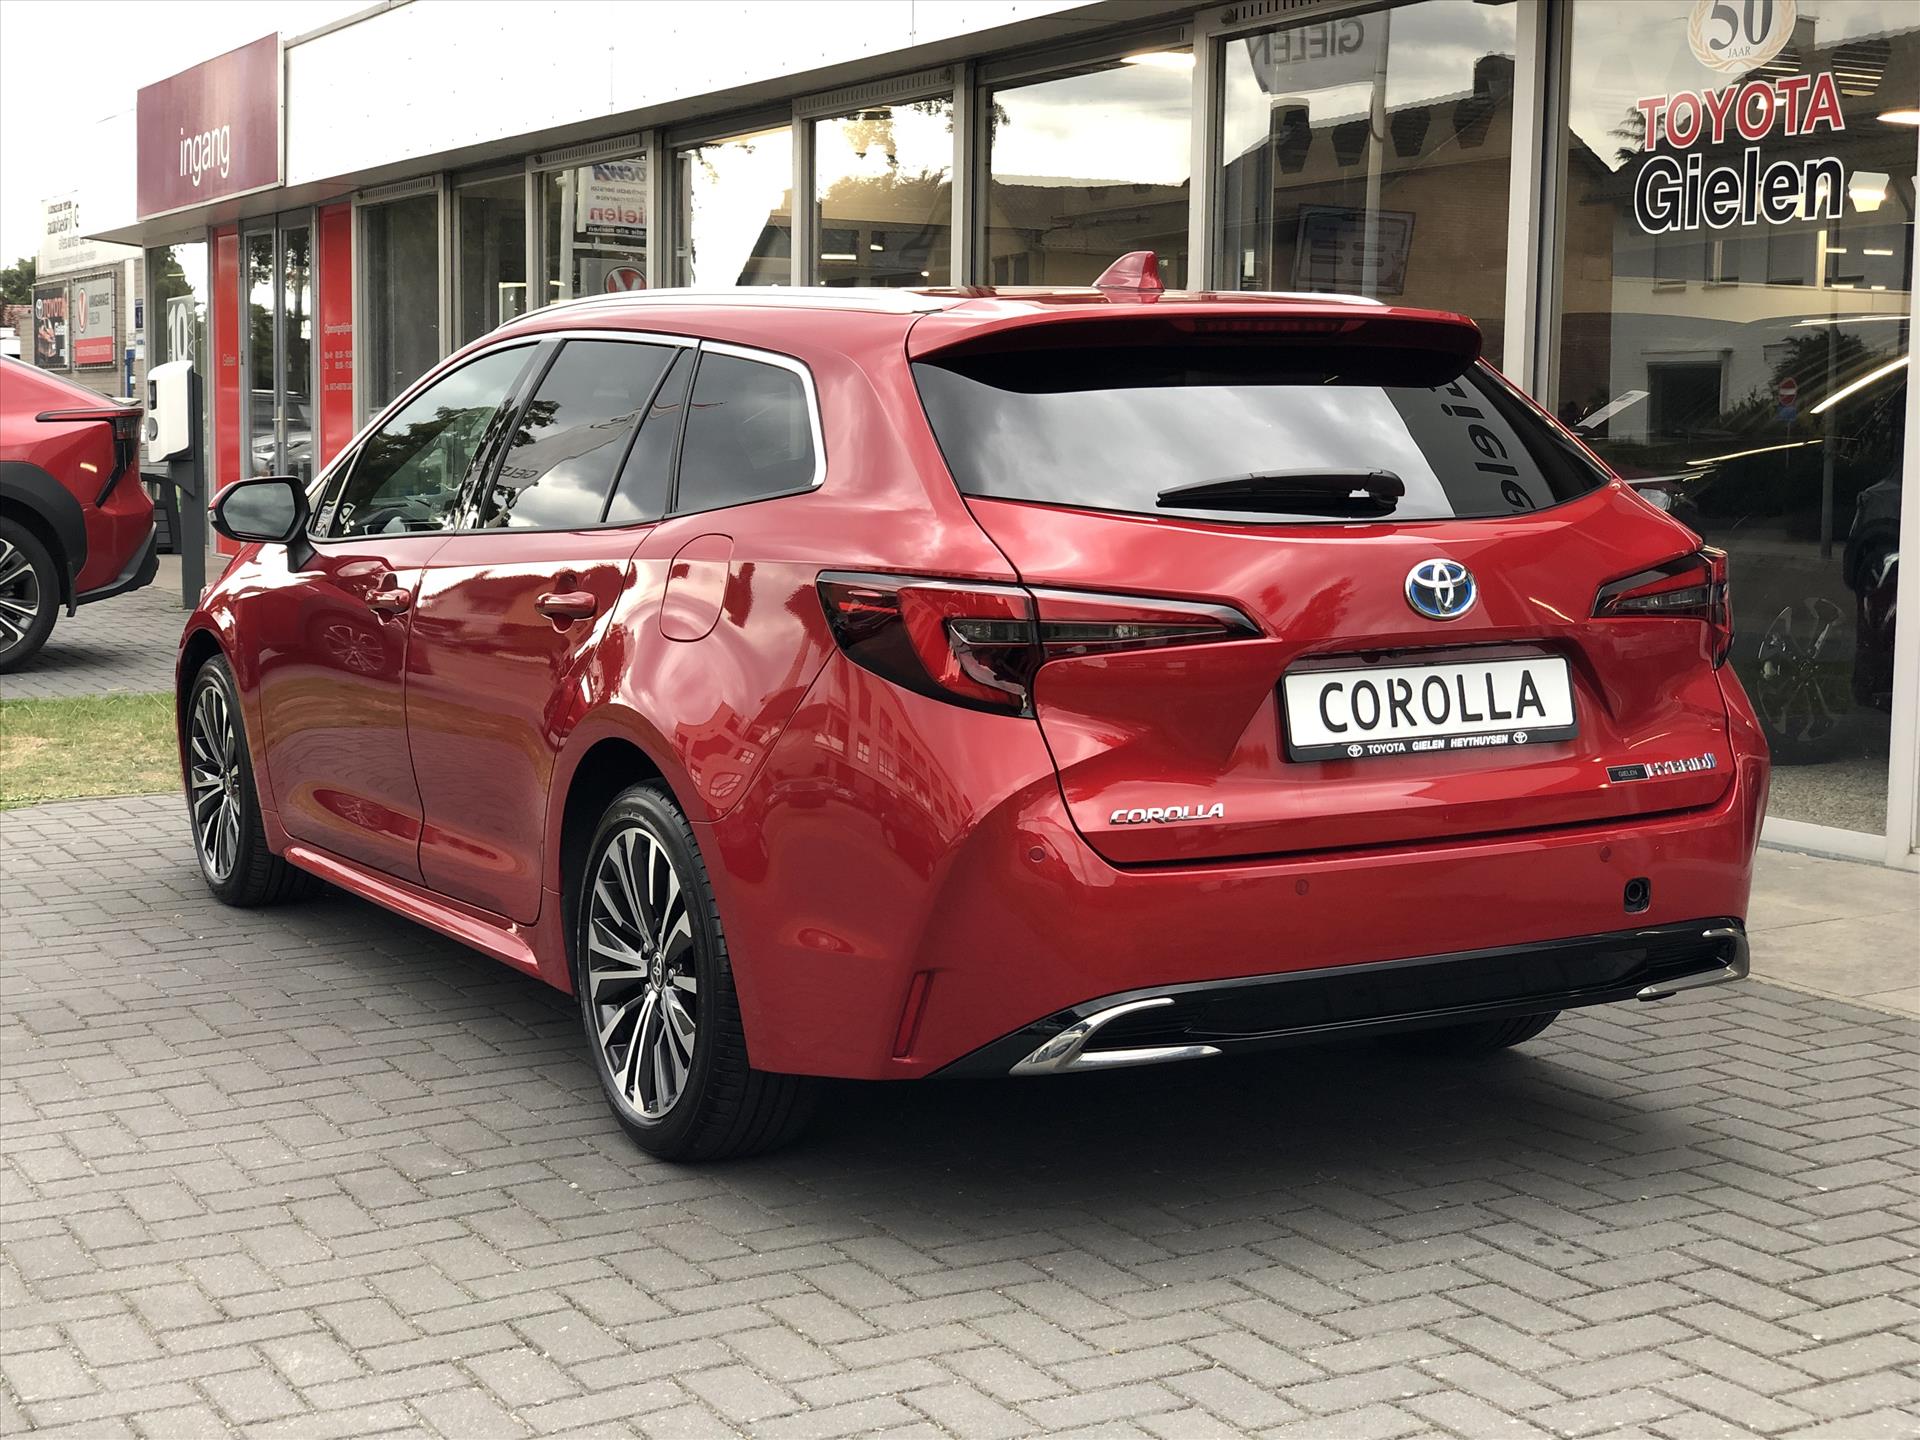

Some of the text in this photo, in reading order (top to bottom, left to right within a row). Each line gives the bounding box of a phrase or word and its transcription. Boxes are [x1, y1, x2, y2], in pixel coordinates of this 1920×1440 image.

[1708, 0, 1773, 51] 50
[1727, 46, 1751, 59] JAAR
[1636, 71, 1846, 152] TOYOTA
[180, 125, 230, 187] ingang
[1634, 147, 1845, 235] Gielen
[1319, 669, 1547, 733] COROLLA
[1367, 734, 1509, 755] TOYOTA GIELEN HEYTHUYSEN
[1646, 753, 1716, 777] HYBRID
[1109, 802, 1225, 825] COROLLA
